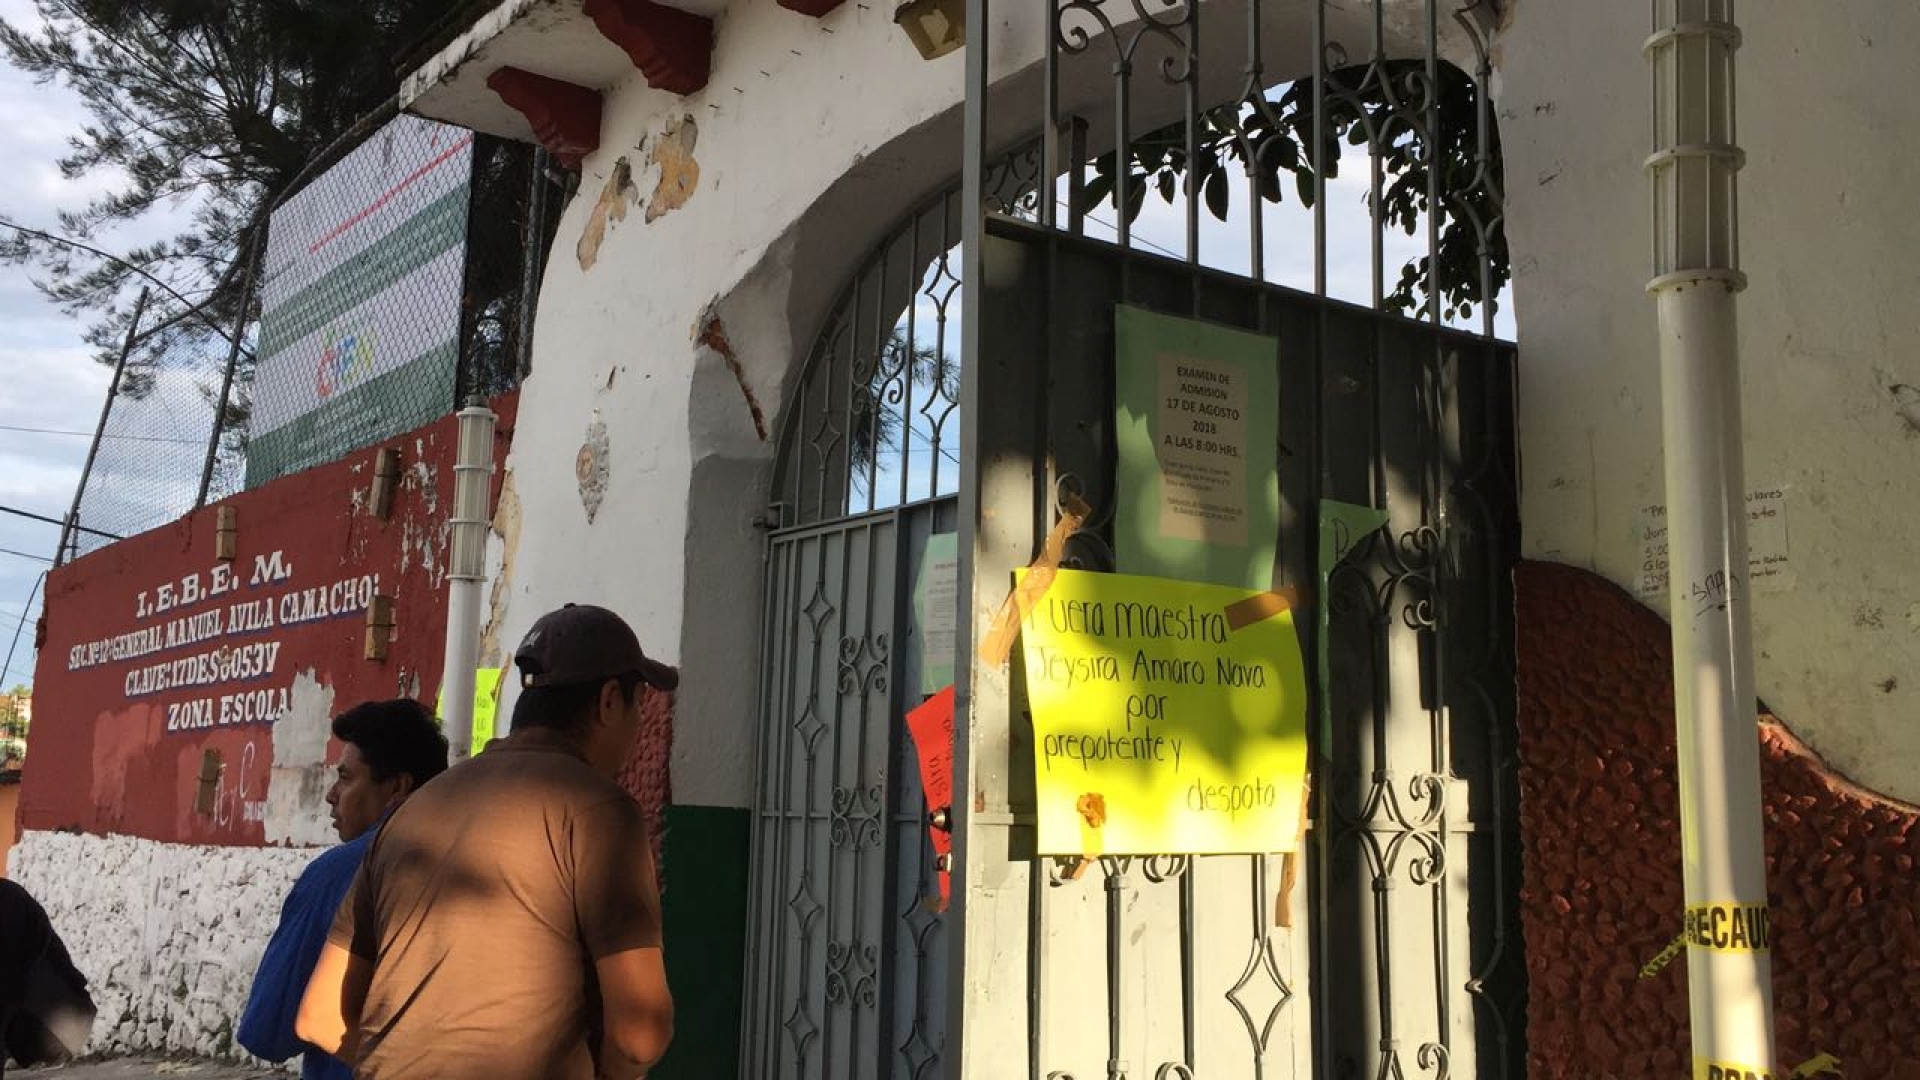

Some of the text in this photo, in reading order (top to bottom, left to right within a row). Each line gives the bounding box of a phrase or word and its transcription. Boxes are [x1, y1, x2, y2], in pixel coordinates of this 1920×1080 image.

[1177, 366, 1217, 382] EXAMEN
[1166, 398, 1240, 420] 17 DE AGOSTO
[1164, 435, 1173, 444] A
[1176, 437, 1194, 448] LAS
[1193, 420, 1217, 434] 2018
[165, 608, 224, 648] MANUEL
[227, 597, 274, 634] AVILA
[1114, 602, 1227, 643] maestra
[1132, 648, 1206, 685] Amaro
[1216, 656, 1267, 688] Nava
[167, 698, 214, 731] ZONA
[1127, 694, 1168, 732] por
[1043, 726, 1183, 775] prepotente y
